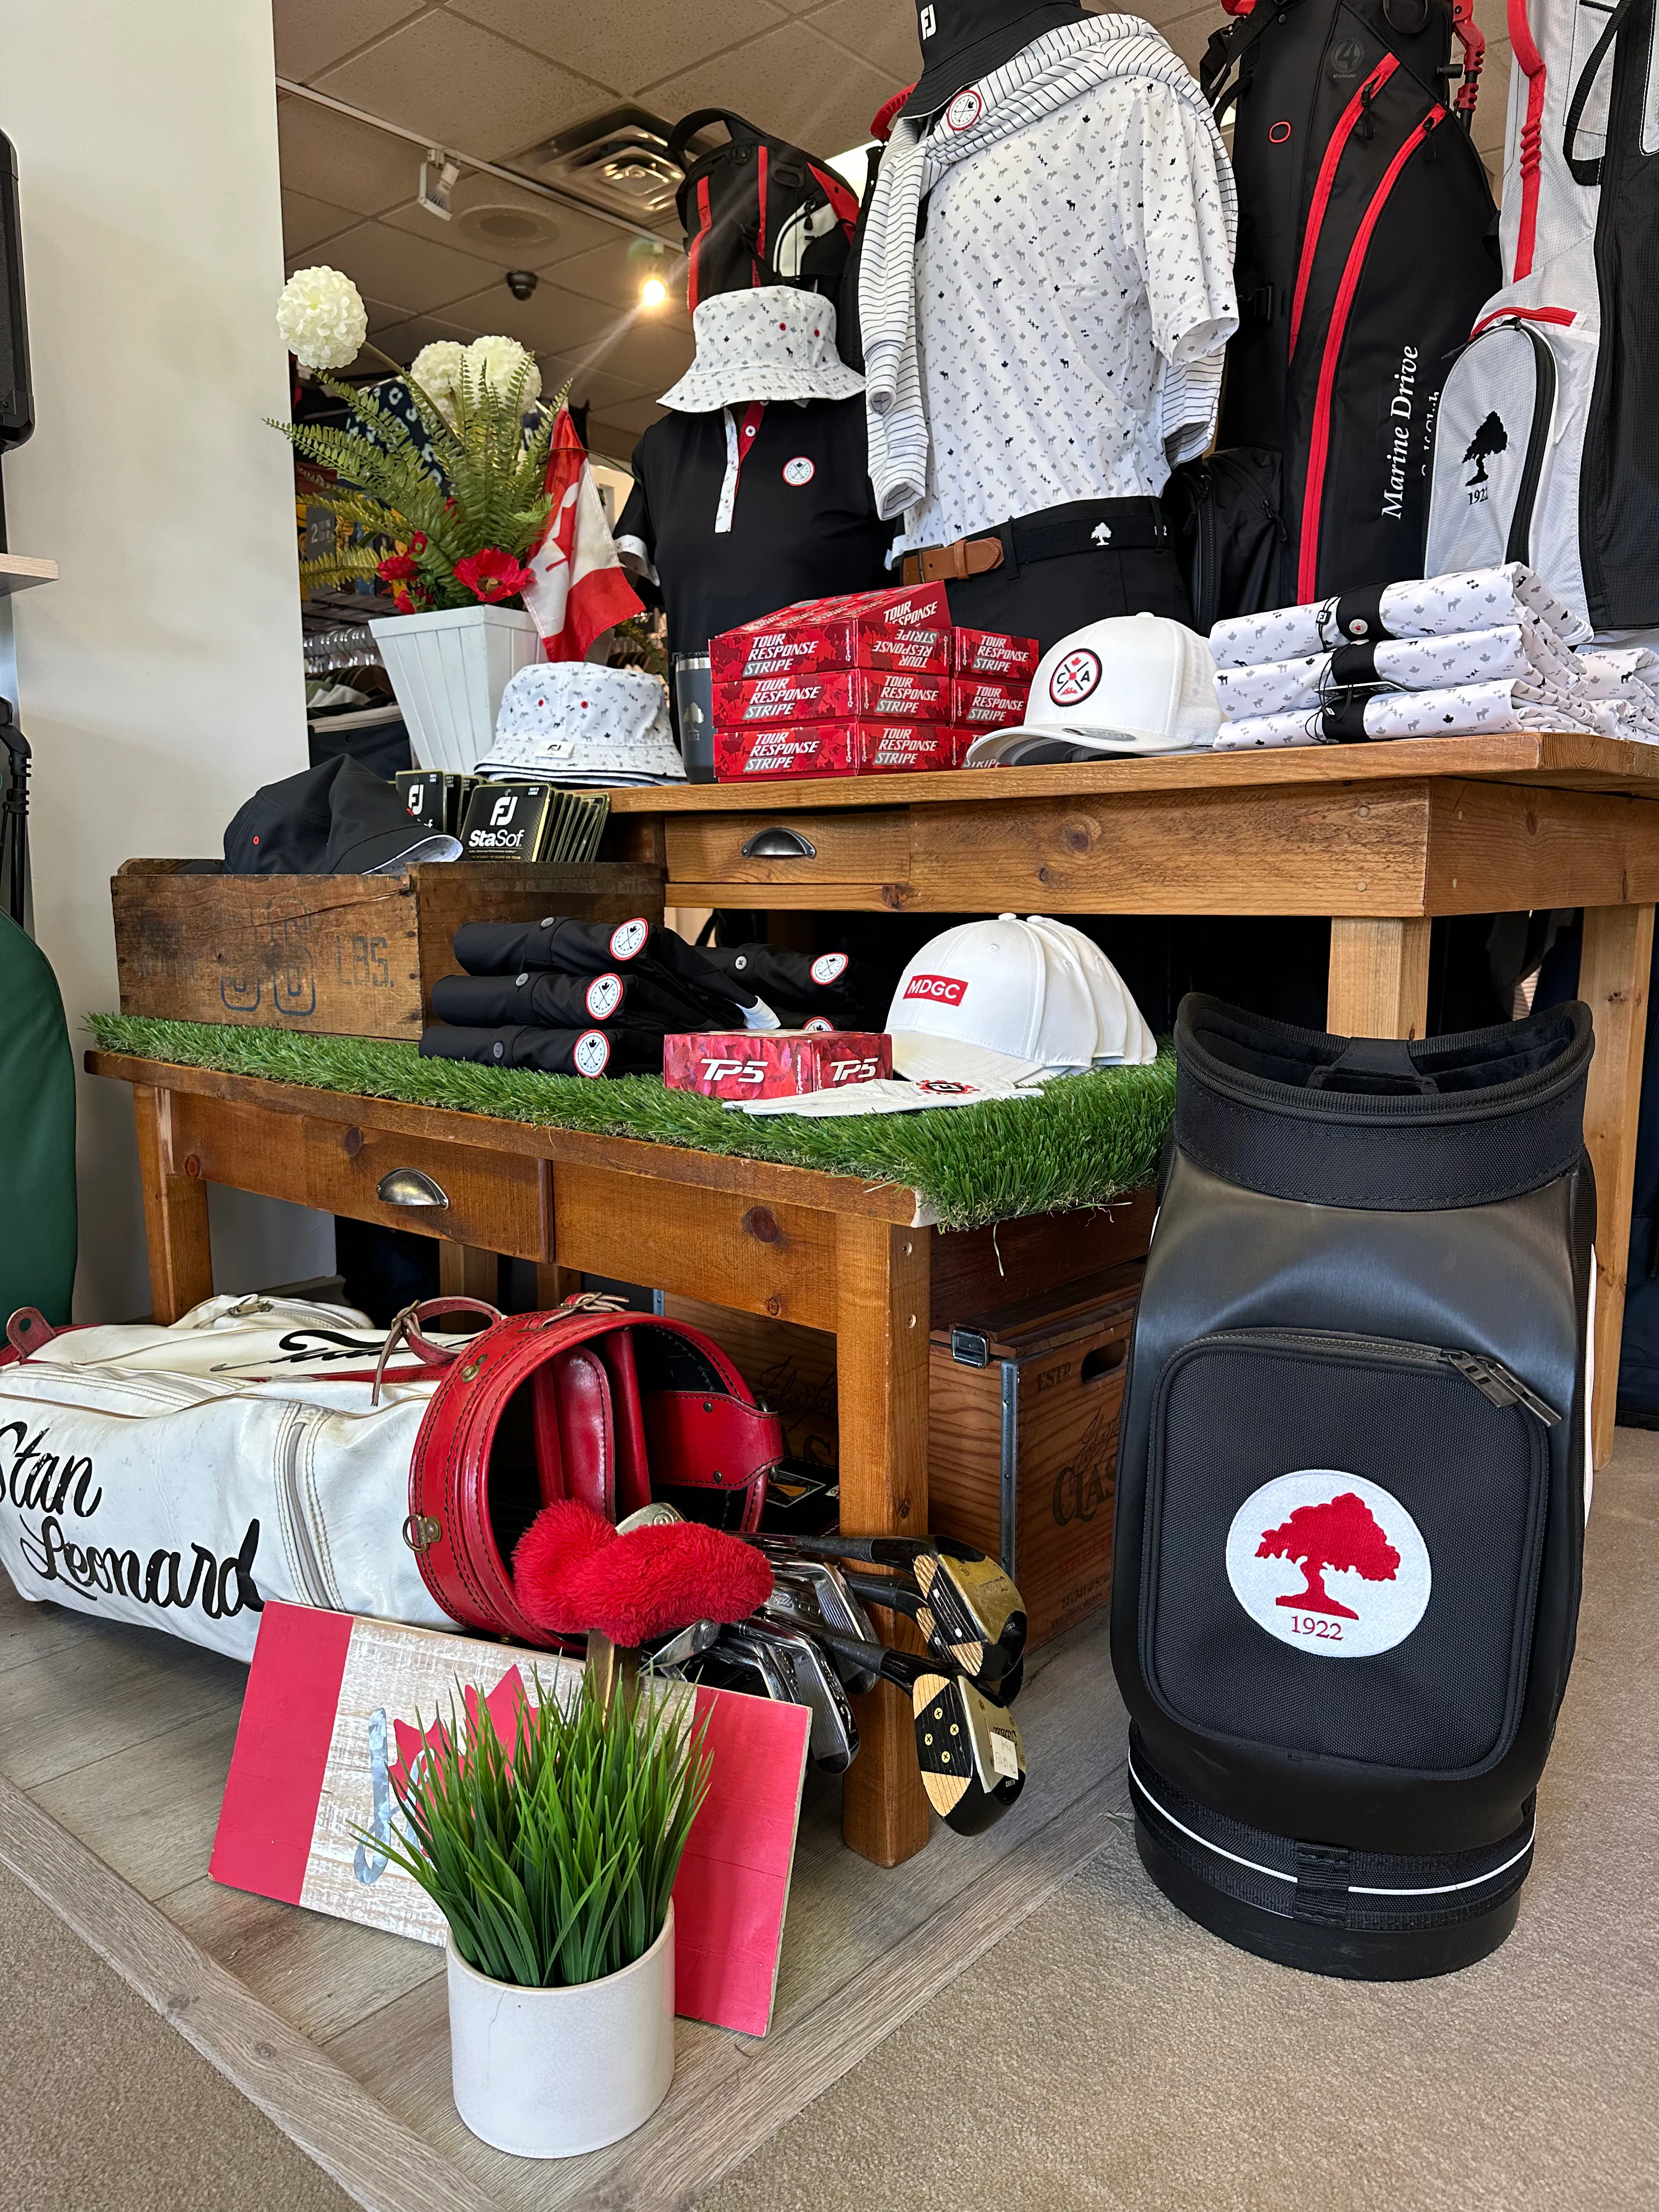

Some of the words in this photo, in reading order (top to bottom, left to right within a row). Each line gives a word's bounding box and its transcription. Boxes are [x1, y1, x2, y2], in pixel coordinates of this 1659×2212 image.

[920, 3, 936, 40] FJ
[1390, 346, 1418, 420] Drive
[1381, 427, 1409, 520] Marine
[883, 600, 912, 623] TOUR
[890, 601, 938, 626] ESPONSE
[1317, 611, 1327, 623] FJ
[752, 633, 786, 650] TOUR
[894, 629, 937, 644] STRIPE
[981, 635, 1007, 648] TOUR
[748, 640, 819, 661] RESPONSE
[871, 640, 933, 657] RESPONSE
[977, 646, 1029, 663] RESPONSE
[744, 658, 794, 676] STRIPE
[898, 655, 929, 668] TOUR
[973, 658, 1012, 673] STRIPE
[884, 675, 914, 689] TOUR
[1080, 670, 1091, 682] A
[755, 678, 790, 692] TOUR
[976, 686, 1002, 699] TOUR
[749, 686, 822, 704] RESPONSE
[879, 686, 939, 702] RESPONSE
[745, 702, 795, 720] STRIPE
[877, 699, 920, 713] STRIPE
[972, 696, 1024, 712] RESPONSE
[968, 708, 1007, 722] STRIPE
[754, 731, 790, 746] TOUR
[882, 727, 912, 740] TOUR
[749, 740, 820, 758] RESPONSE
[878, 739, 939, 752] RESPONSE
[745, 755, 795, 771] STRIPE
[874, 752, 919, 765] STRIPE
[409, 784, 424, 815] FJ
[490, 796, 517, 826] FJ
[907, 979, 961, 999] MDGC
[700, 1058, 769, 1083] TP5
[830, 1057, 878, 1081] TP5
[0, 1421, 103, 1517] Stan
[20, 1515, 265, 1620] Leonard
[1291, 1615, 1344, 1641] 1922
